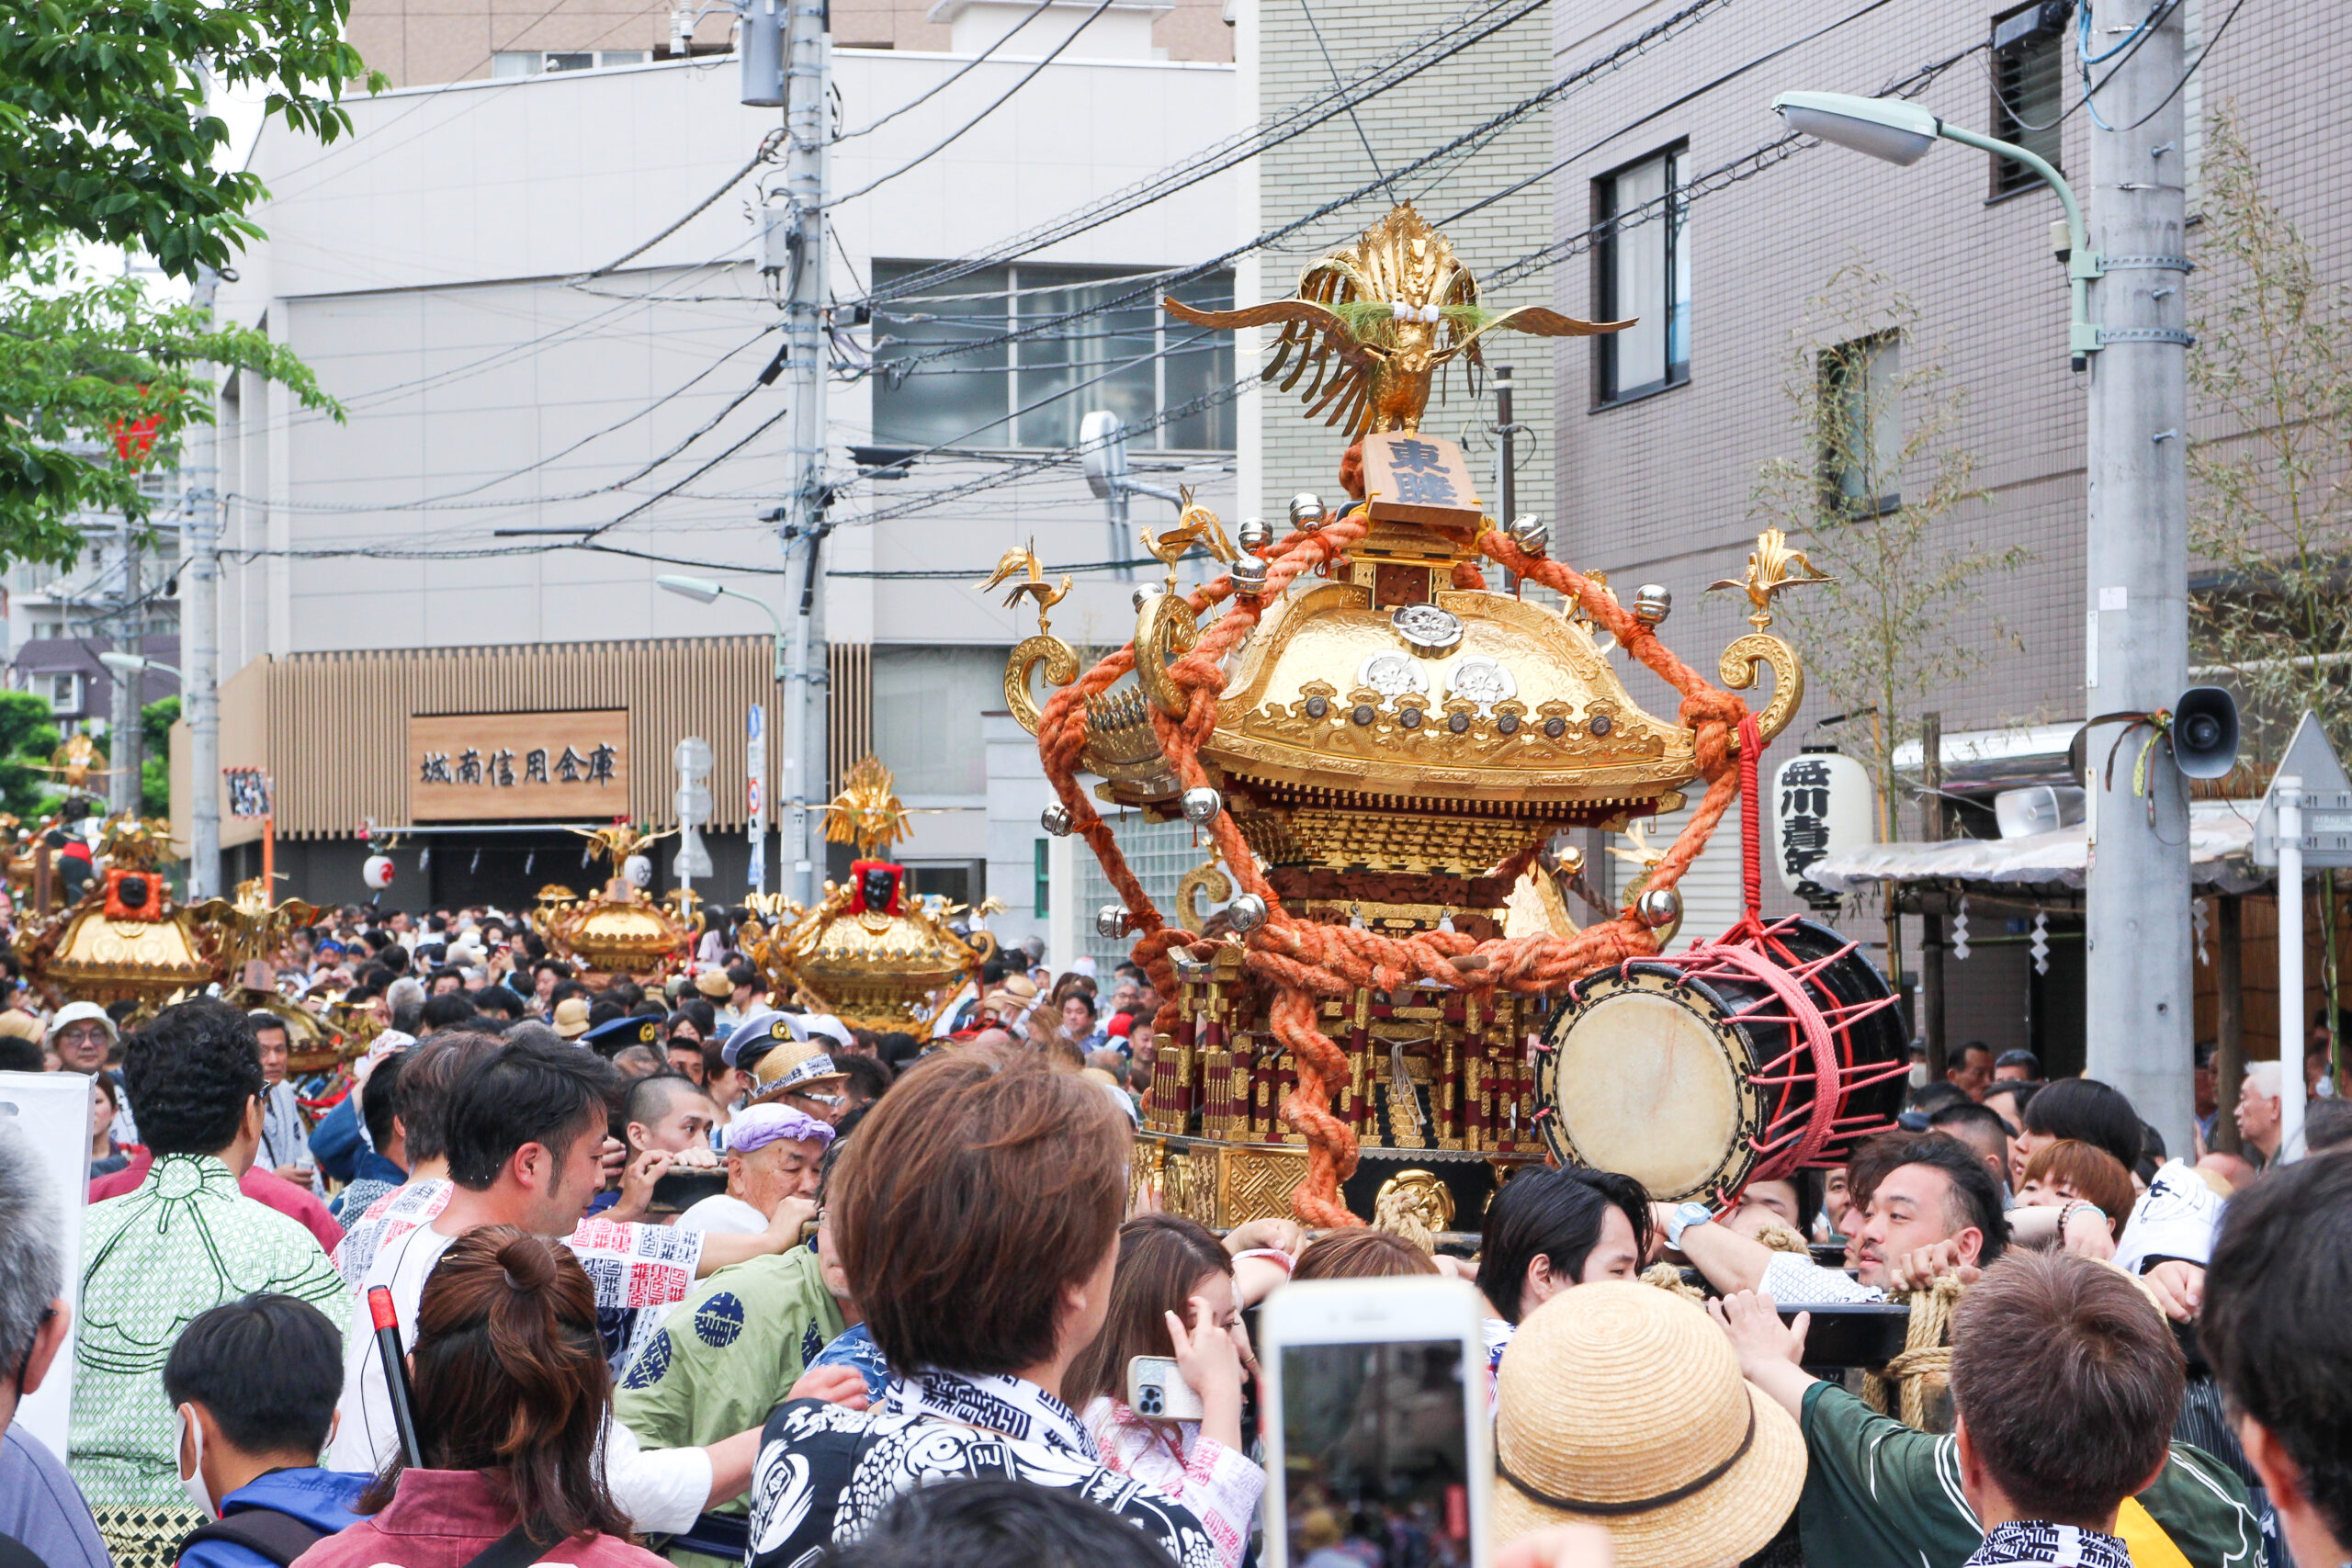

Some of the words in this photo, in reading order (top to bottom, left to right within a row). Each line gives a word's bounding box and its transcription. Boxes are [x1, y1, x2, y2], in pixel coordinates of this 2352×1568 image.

[1387, 438, 1458, 505] 東睦
[420, 741, 618, 788] 城南信用金庫
